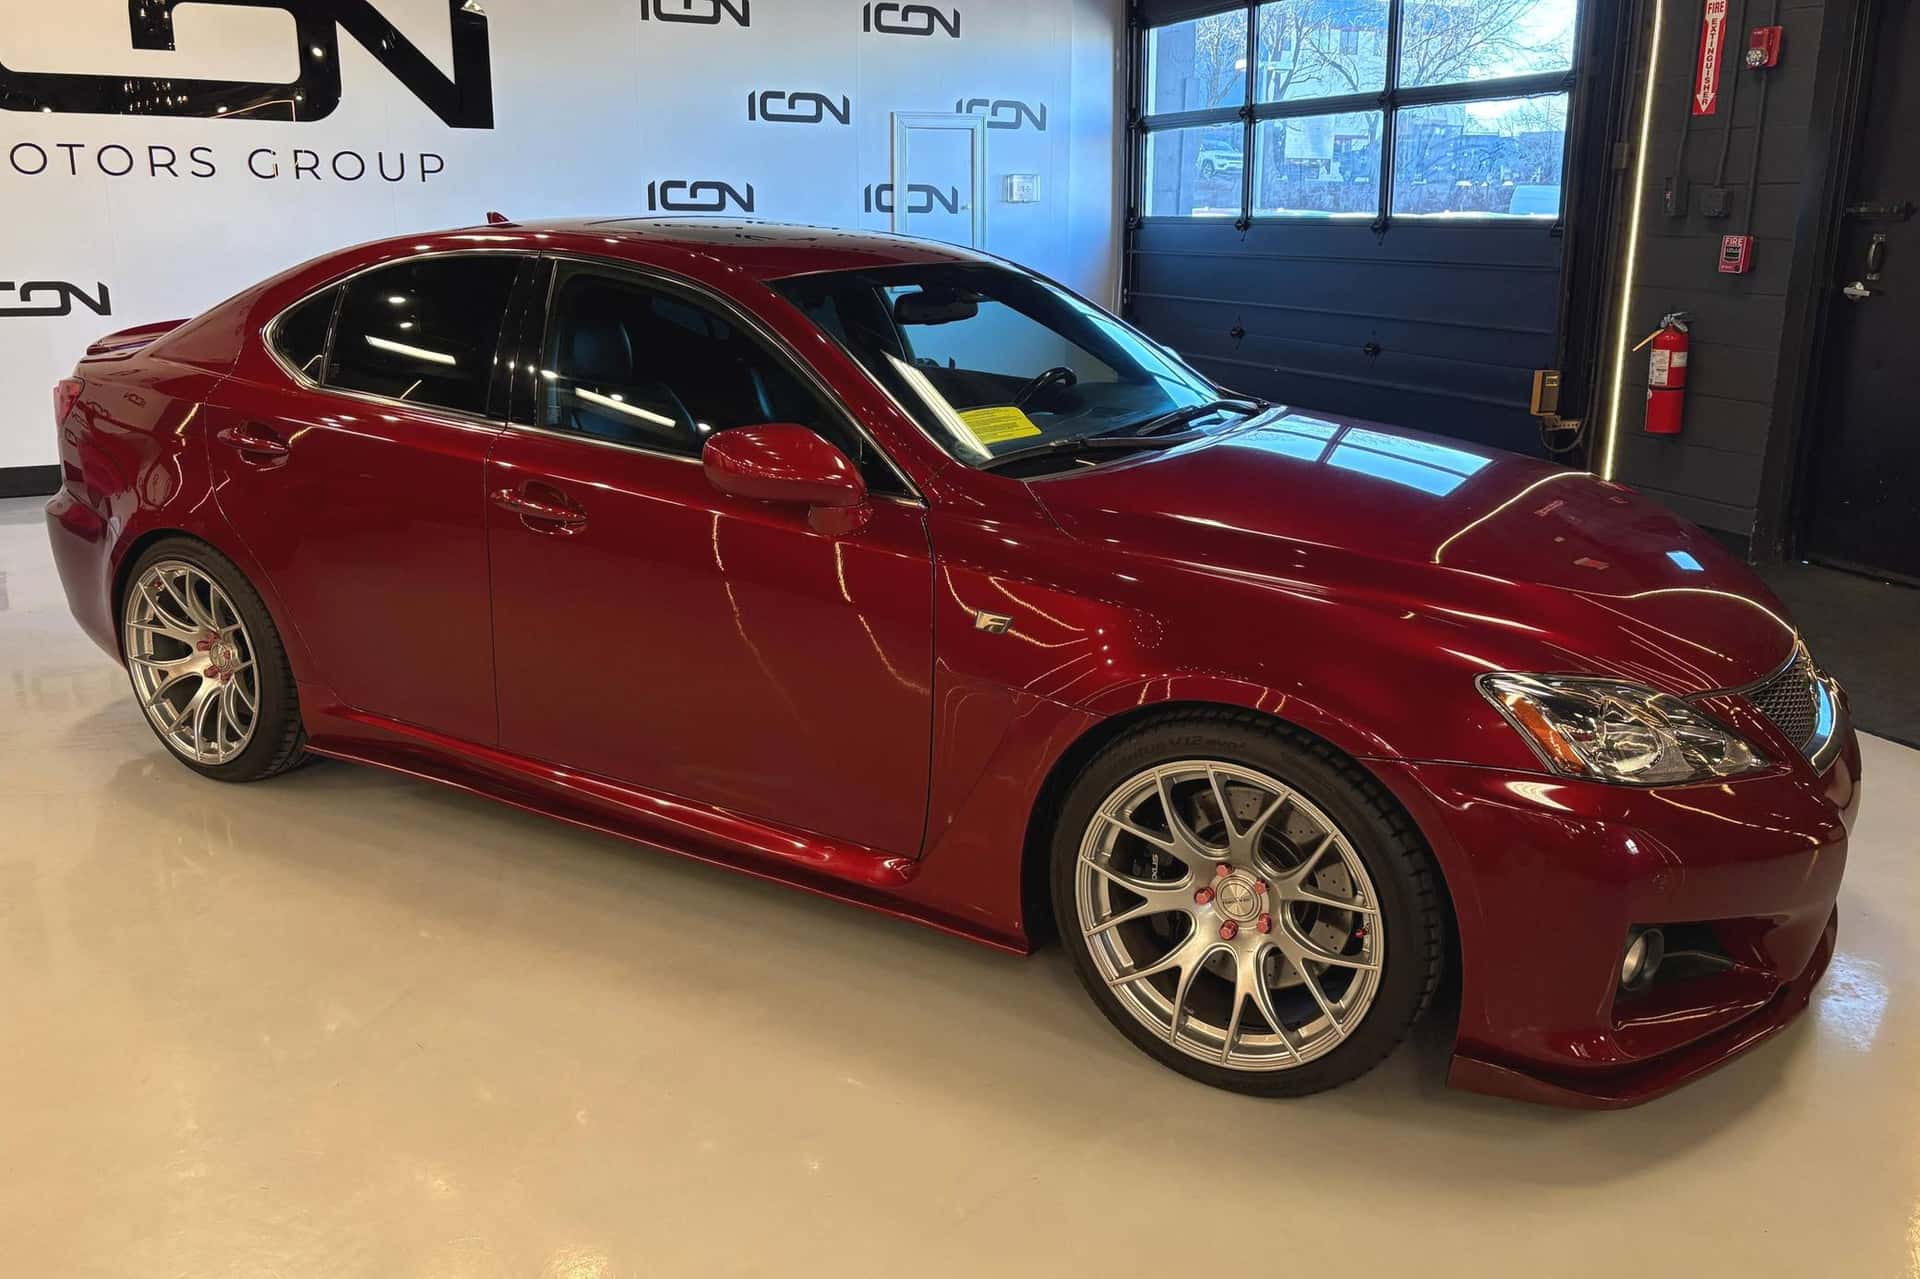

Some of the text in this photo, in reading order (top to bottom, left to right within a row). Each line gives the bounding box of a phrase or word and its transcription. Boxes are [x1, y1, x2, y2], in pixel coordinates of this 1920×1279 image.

[863, 2, 960, 38] ICON
[1708, 1, 1724, 14] FIRE
[1702, 18, 1717, 105] EXTINGUISHER
[748, 90, 850, 125] ICON
[9, 143, 445, 183] OTORS GROUP
[648, 180, 754, 213] ICON
[1725, 237, 1744, 246] FIRE
